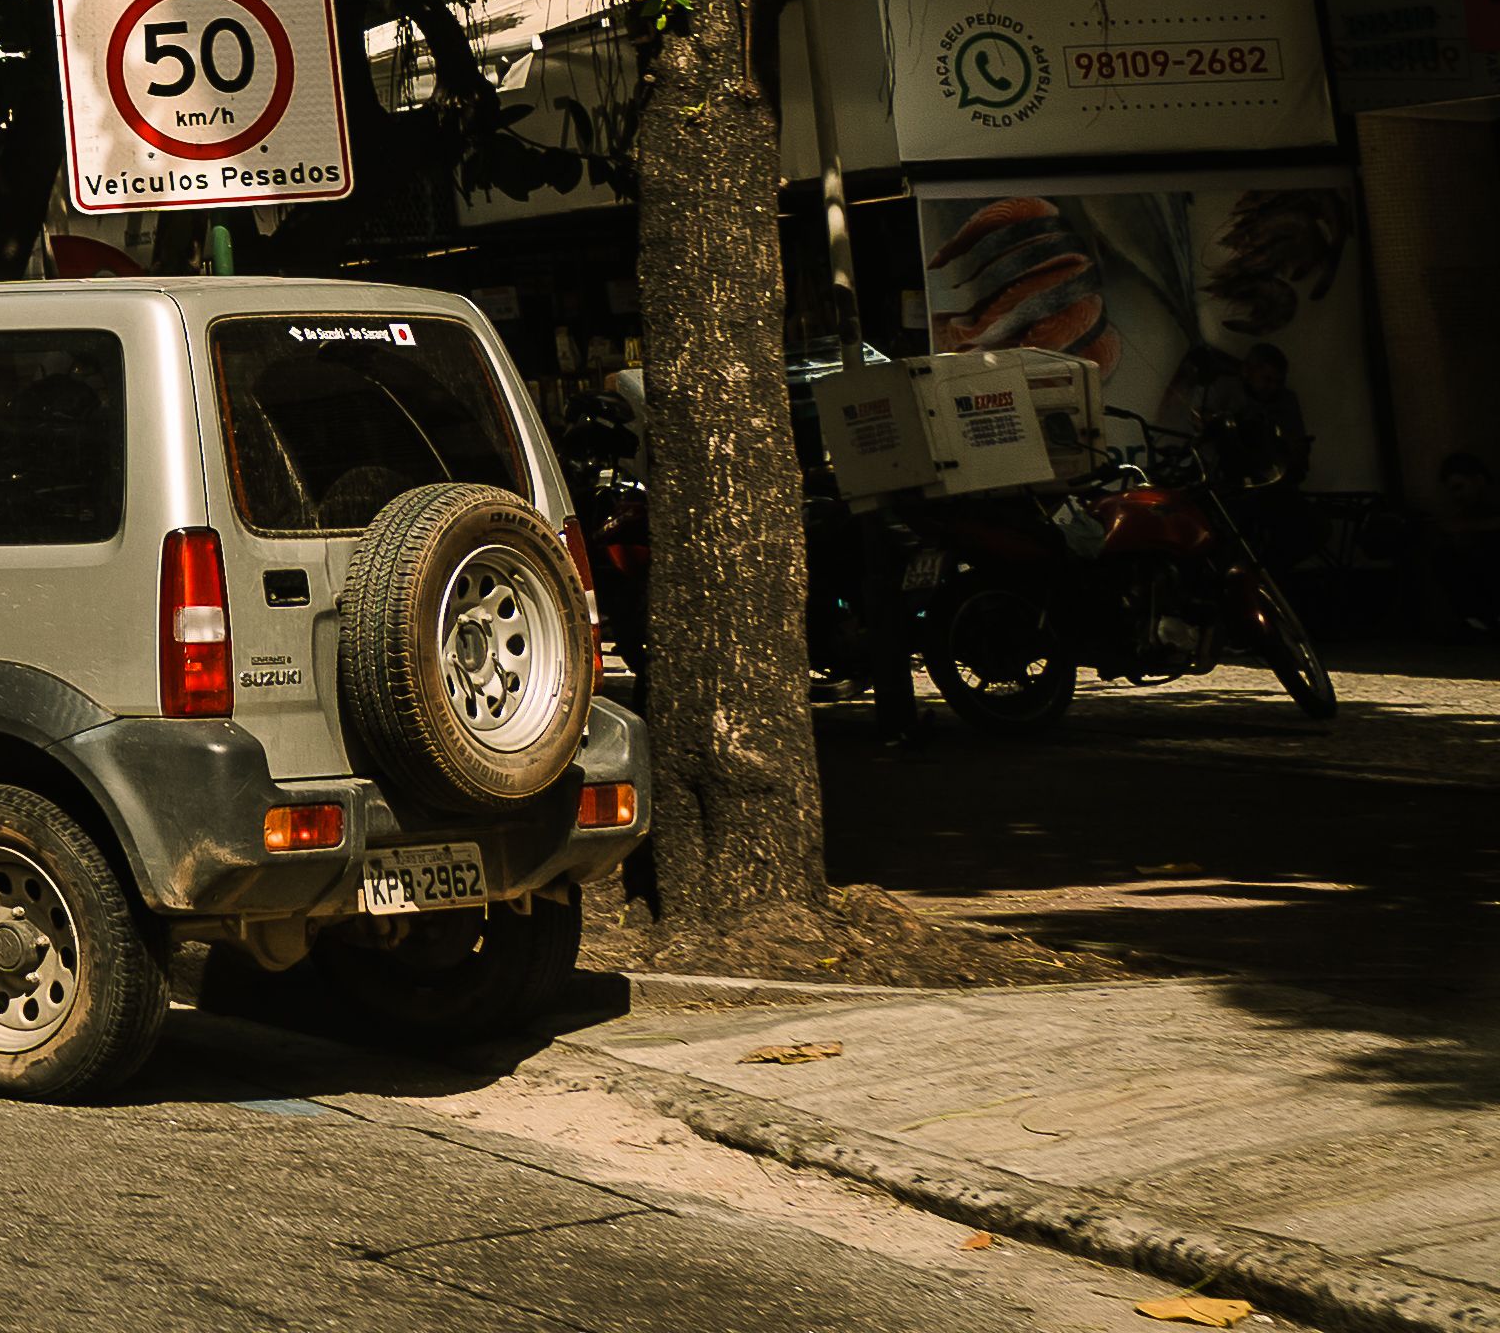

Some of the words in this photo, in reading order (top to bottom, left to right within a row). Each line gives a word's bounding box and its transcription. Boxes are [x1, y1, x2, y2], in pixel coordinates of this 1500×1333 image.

[940, 22, 965, 52] SEU
[964, 13, 1025, 35] PEDIDO
[143, 17, 256, 98] 50
[1074, 46, 1269, 80] 98109-2682
[936, 55, 957, 99] FAÇA
[971, 110, 1013, 128] PELO
[1013, 44, 1052, 122] WHATSAPP
[175, 107, 236, 127] km/h
[85, 171, 209, 196] Veículos
[221, 162, 341, 188] Pesados
[974, 391, 1014, 411] EXPRESS
[239, 670, 302, 688] SUZUKI
